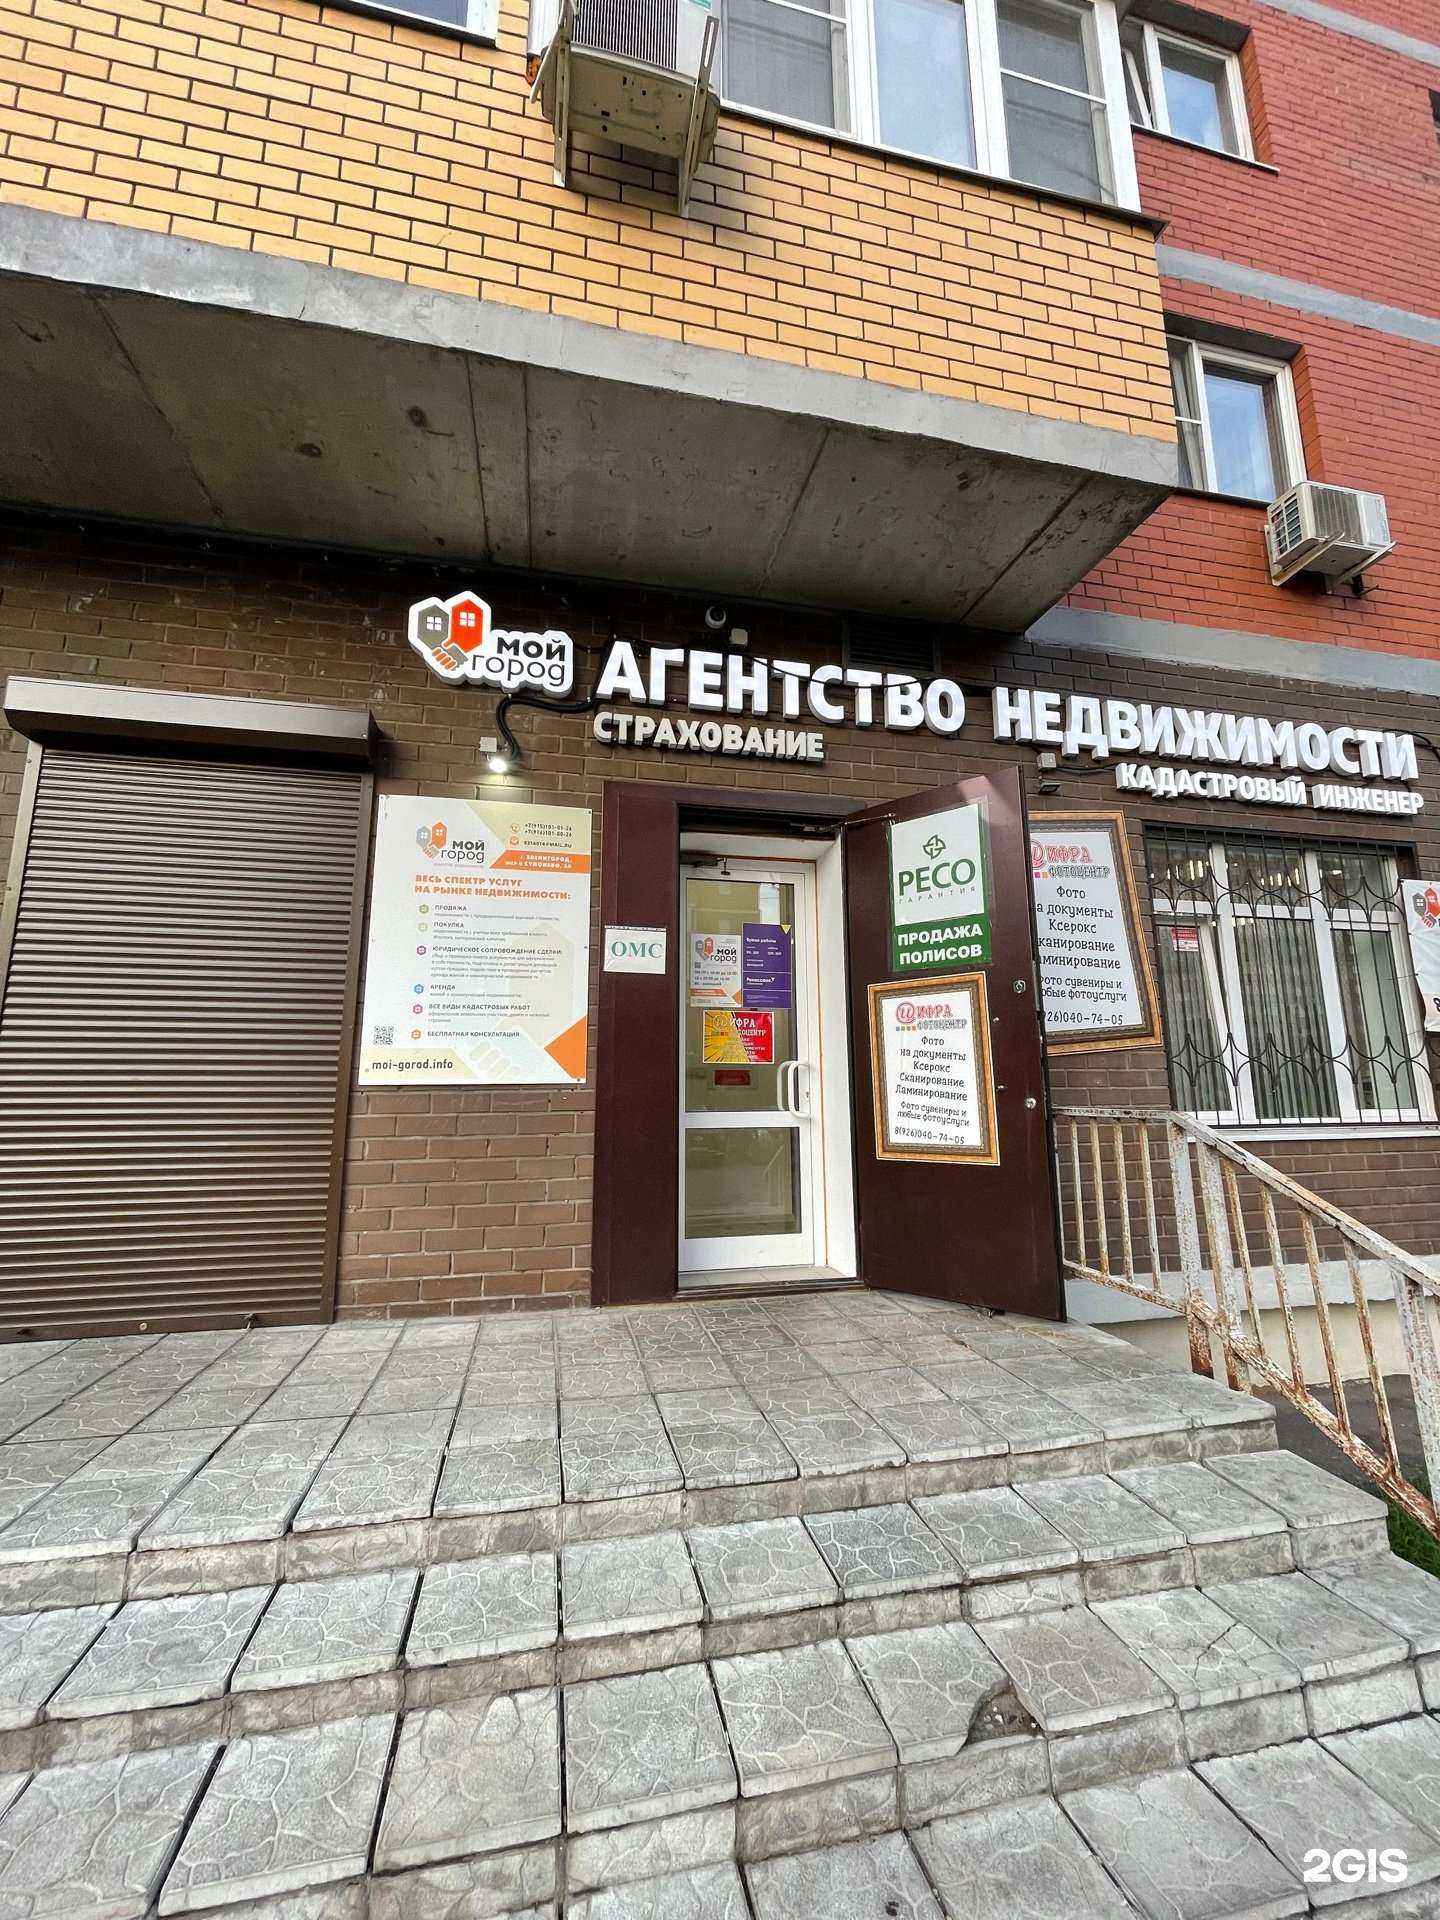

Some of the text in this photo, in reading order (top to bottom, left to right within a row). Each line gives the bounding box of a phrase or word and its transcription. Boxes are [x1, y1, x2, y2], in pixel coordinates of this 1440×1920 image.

[472, 654, 565, 686] город
[596, 640, 1420, 781] АГЕНТСТВО НЕДВИЖИМОСТИ
[593, 712, 825, 761] СТРАХОВАНИЕ
[1115, 762, 1425, 815] КАДАСТРОВЫЙ ИНЖЕНЕР
[441, 849, 485, 863] город
[416, 874, 523, 886] ВЕСЬ СПЕКТР УСЛУГ
[898, 858, 976, 897] РЕСО
[415, 885, 571, 900] НА РЫНКЕ НЕДВИЖИМОСТИ:
[899, 886, 976, 905] ГАРАНТИЯ
[1056, 885, 1086, 899] Фото
[1047, 903, 1114, 920] документы
[1049, 918, 1097, 935] Ксерокс
[897, 923, 984, 947] ПРОДАЖА
[432, 945, 479, 953] ЮРИДИЧЕСКОЕ
[480, 947, 535, 955] СОПРОВОЖДЕНИЕ
[611, 941, 663, 959] ОМС
[1036, 937, 1115, 953] канирование
[899, 943, 983, 965] ПОЛИСОВ
[1040, 954, 1121, 970] минирование
[1065, 977, 1114, 991] сувениры
[1116, 980, 1123, 990] и
[1068, 988, 1128, 1004] фотоуслуги
[1046, 1010, 1124, 1026] 26)040-74-05
[921, 1036, 945, 1046] Фото
[900, 1048, 967, 1061] на документы
[372, 1058, 453, 1072] moi-gorod.info
[913, 1060, 951, 1073] Ксерокс
[899, 1072, 965, 1088] Сканирование
[895, 1084, 968, 1102] Ламинирование
[897, 1110, 921, 1120] любые
[921, 1104, 960, 1117] сувениры
